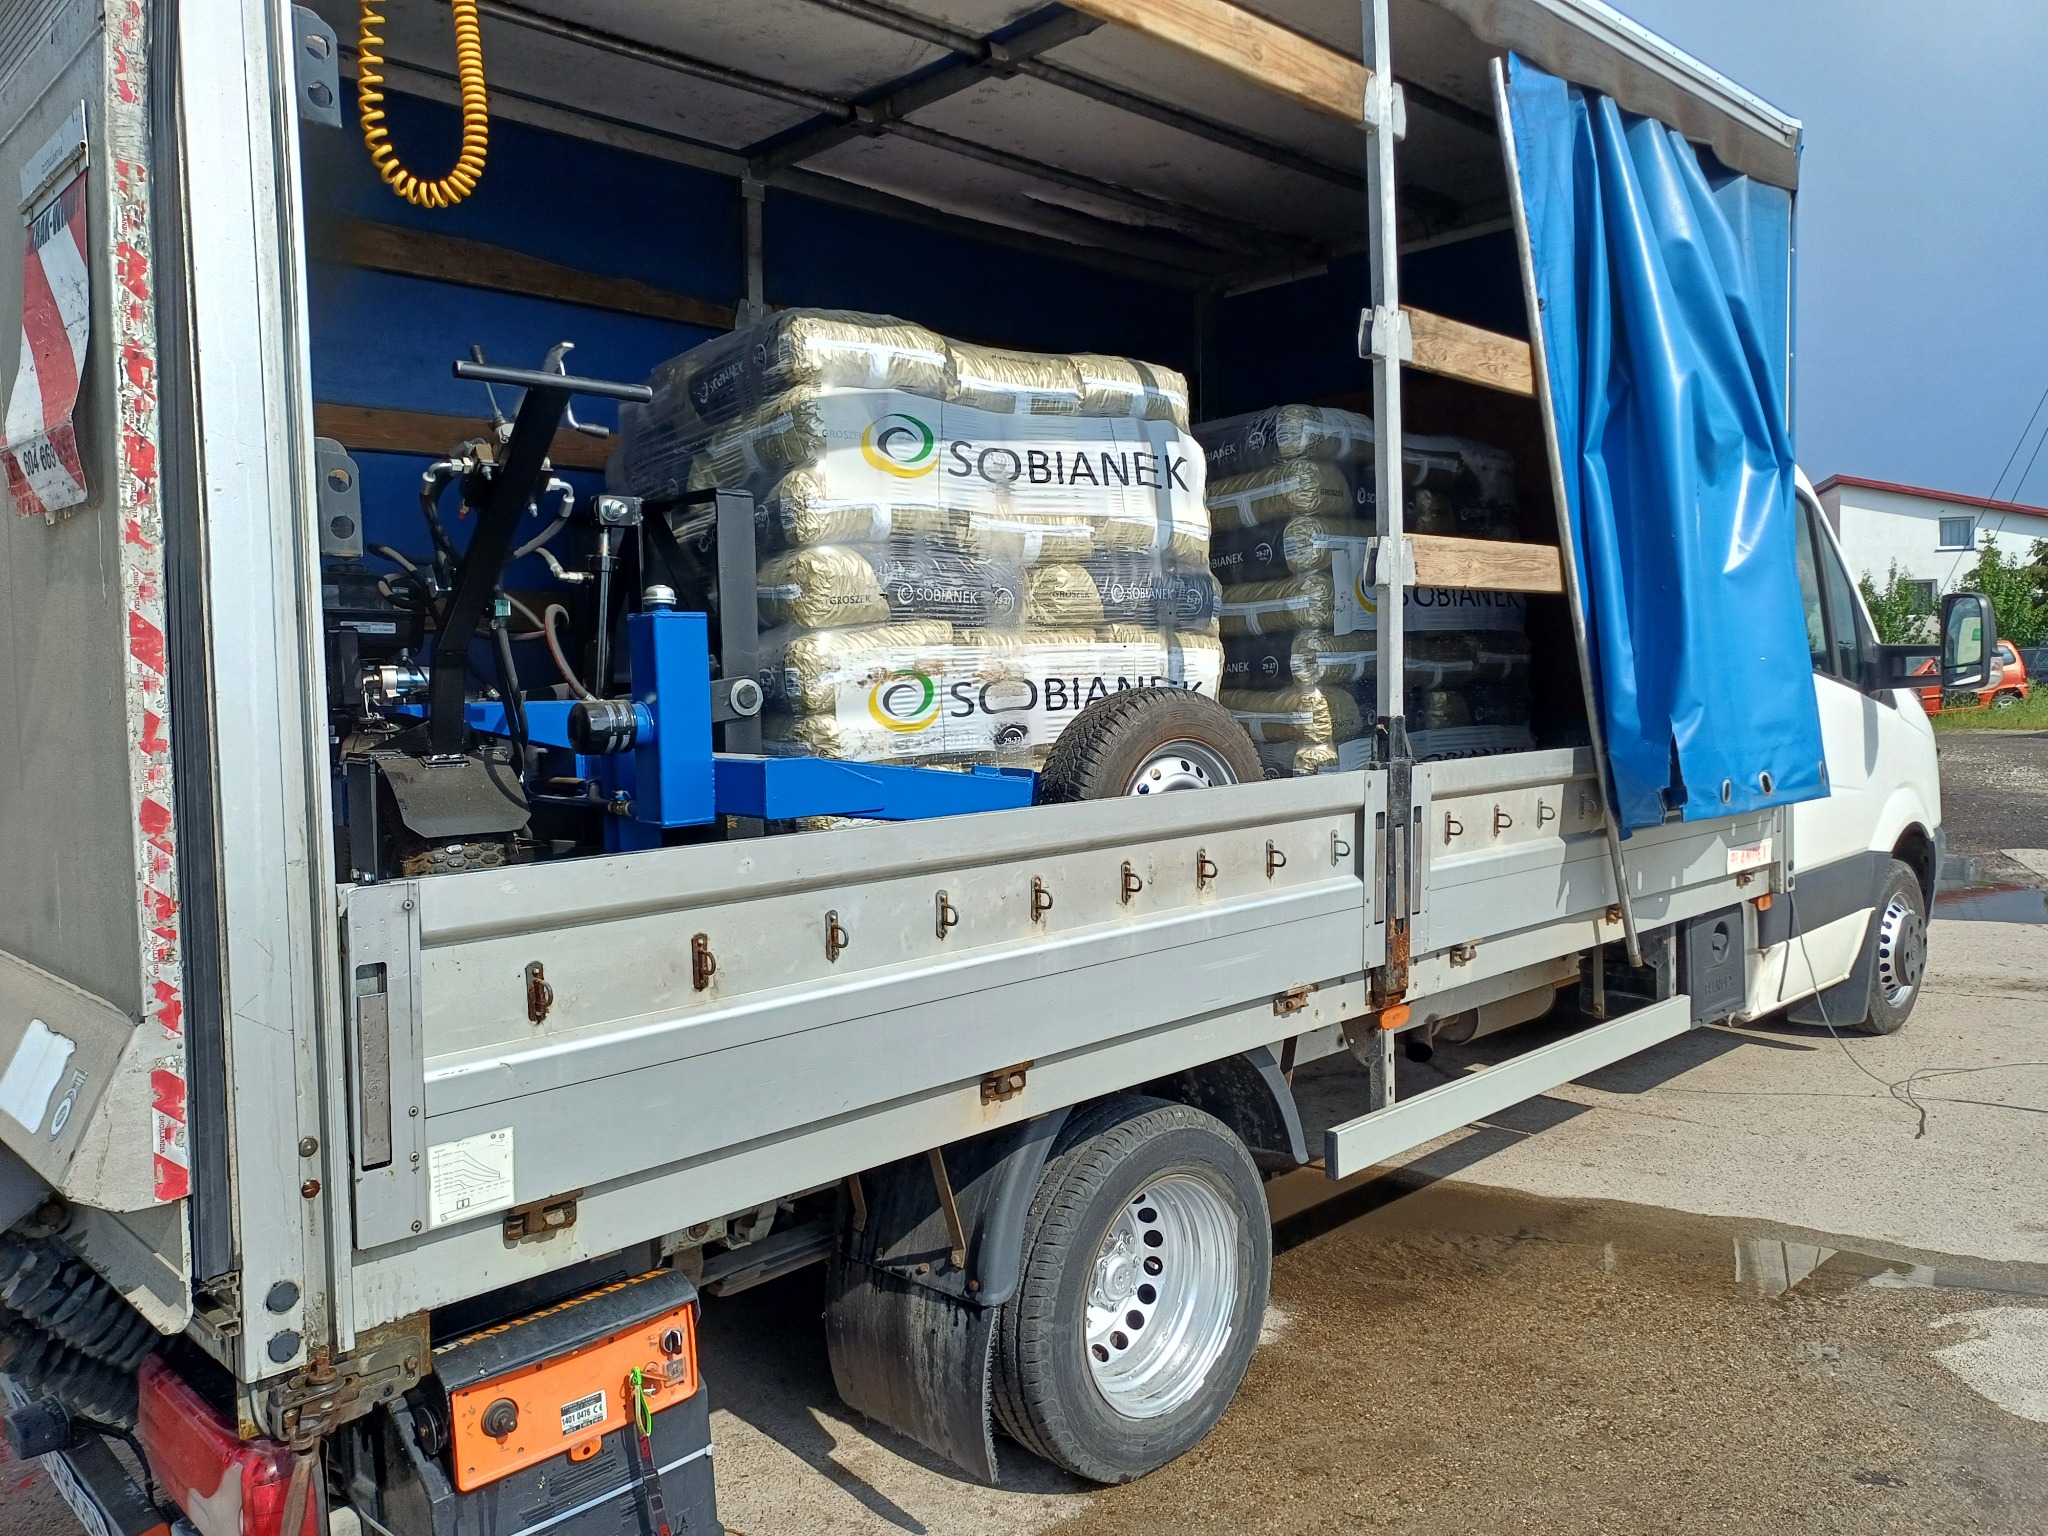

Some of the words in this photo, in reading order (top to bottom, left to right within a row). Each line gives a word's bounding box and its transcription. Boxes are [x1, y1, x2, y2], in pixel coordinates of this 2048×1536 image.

[23, 446, 40, 477] 604
[40, 442, 57, 472] 669
[947, 440, 1190, 492] SOBIANEK
[1211, 551, 1244, 569] BIANEK
[829, 593, 872, 606] GROSZEK
[916, 588, 978, 605] SOBIANEK
[1127, 586, 1174, 601] SOBIANEK
[1003, 736, 1021, 745] 29-27
[151, 935, 160, 977] DHOLLADIA
[158, 1115, 166, 1155] DHOLLANDIA
[432, 1269, 669, 1355] DHOLLANDIA
[562, 1414, 576, 1426] 1401
[576, 1408, 591, 1420] 0476
